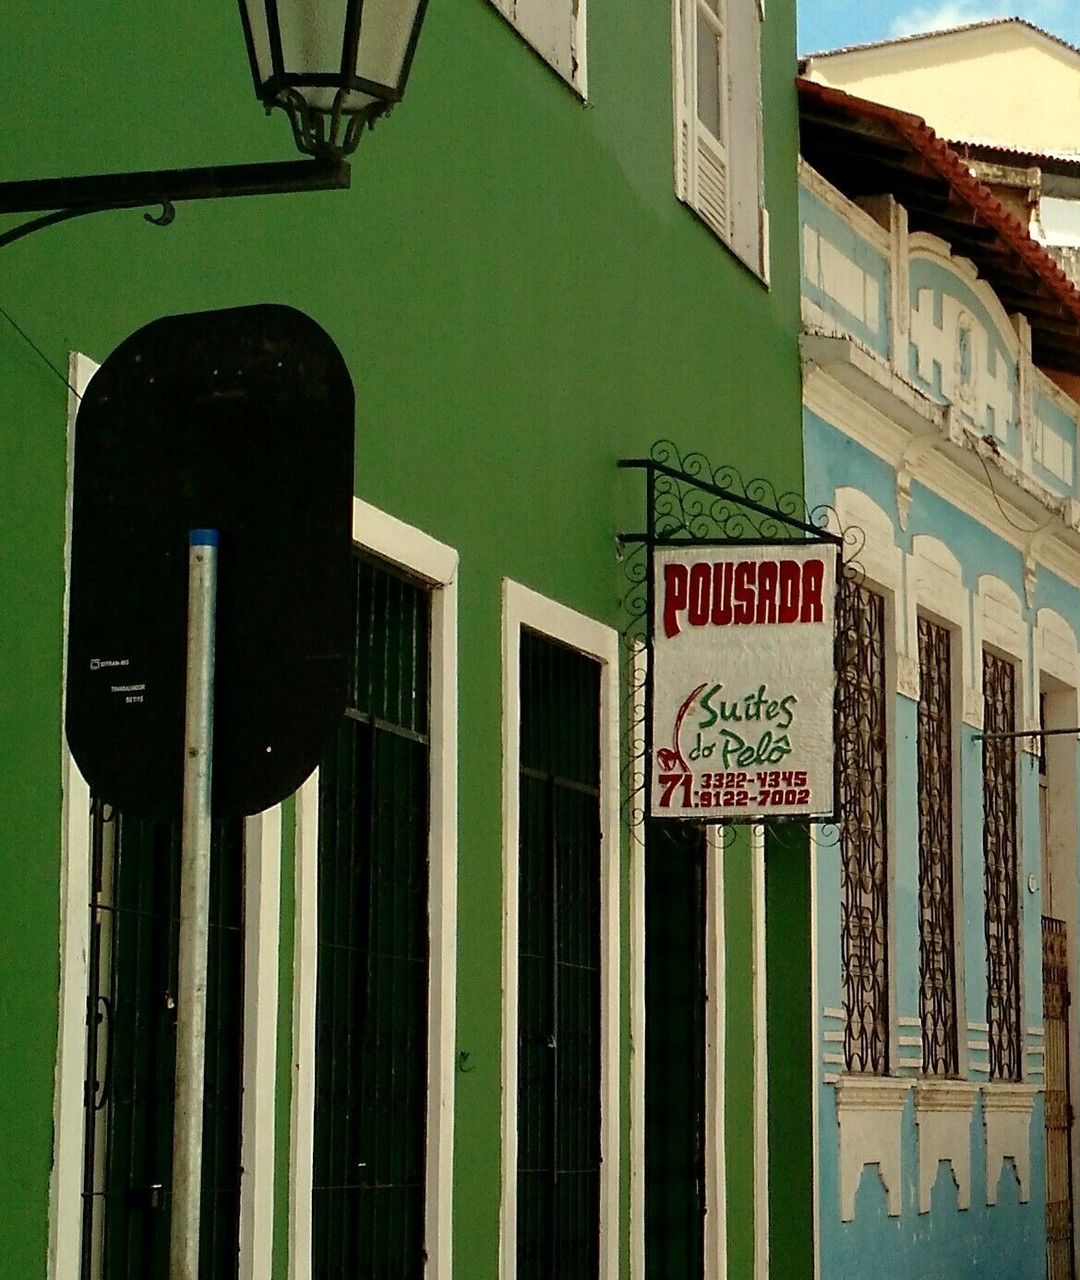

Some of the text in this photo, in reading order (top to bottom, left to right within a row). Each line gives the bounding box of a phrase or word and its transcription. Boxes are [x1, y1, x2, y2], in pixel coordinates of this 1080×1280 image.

[663, 559, 825, 640] POUSADA
[689, 728, 793, 770] do Pelô
[700, 771, 808, 789] 3322-4345
[700, 789, 811, 808] 9122-7002
